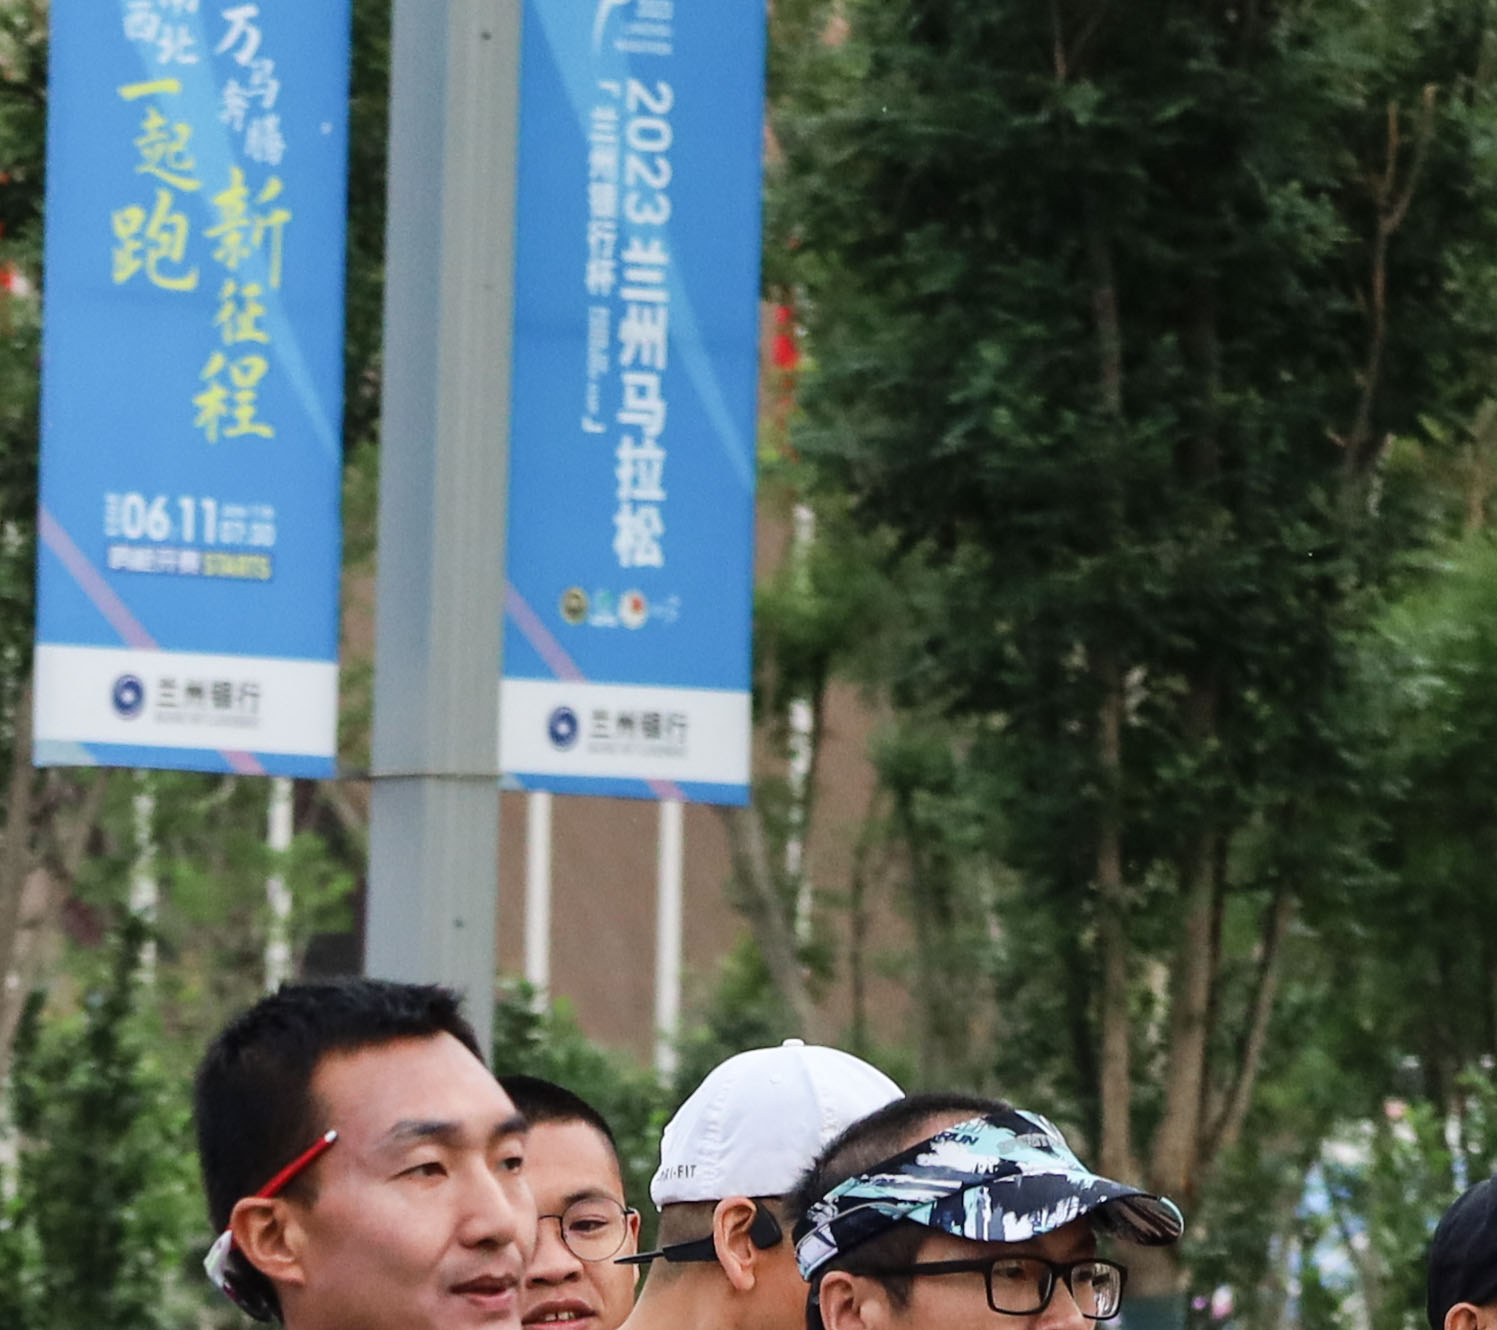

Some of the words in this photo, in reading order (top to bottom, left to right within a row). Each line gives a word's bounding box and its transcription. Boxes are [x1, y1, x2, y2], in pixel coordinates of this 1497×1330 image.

[112, 77, 202, 292] 一起跑
[204, 166, 293, 445] 新征程
